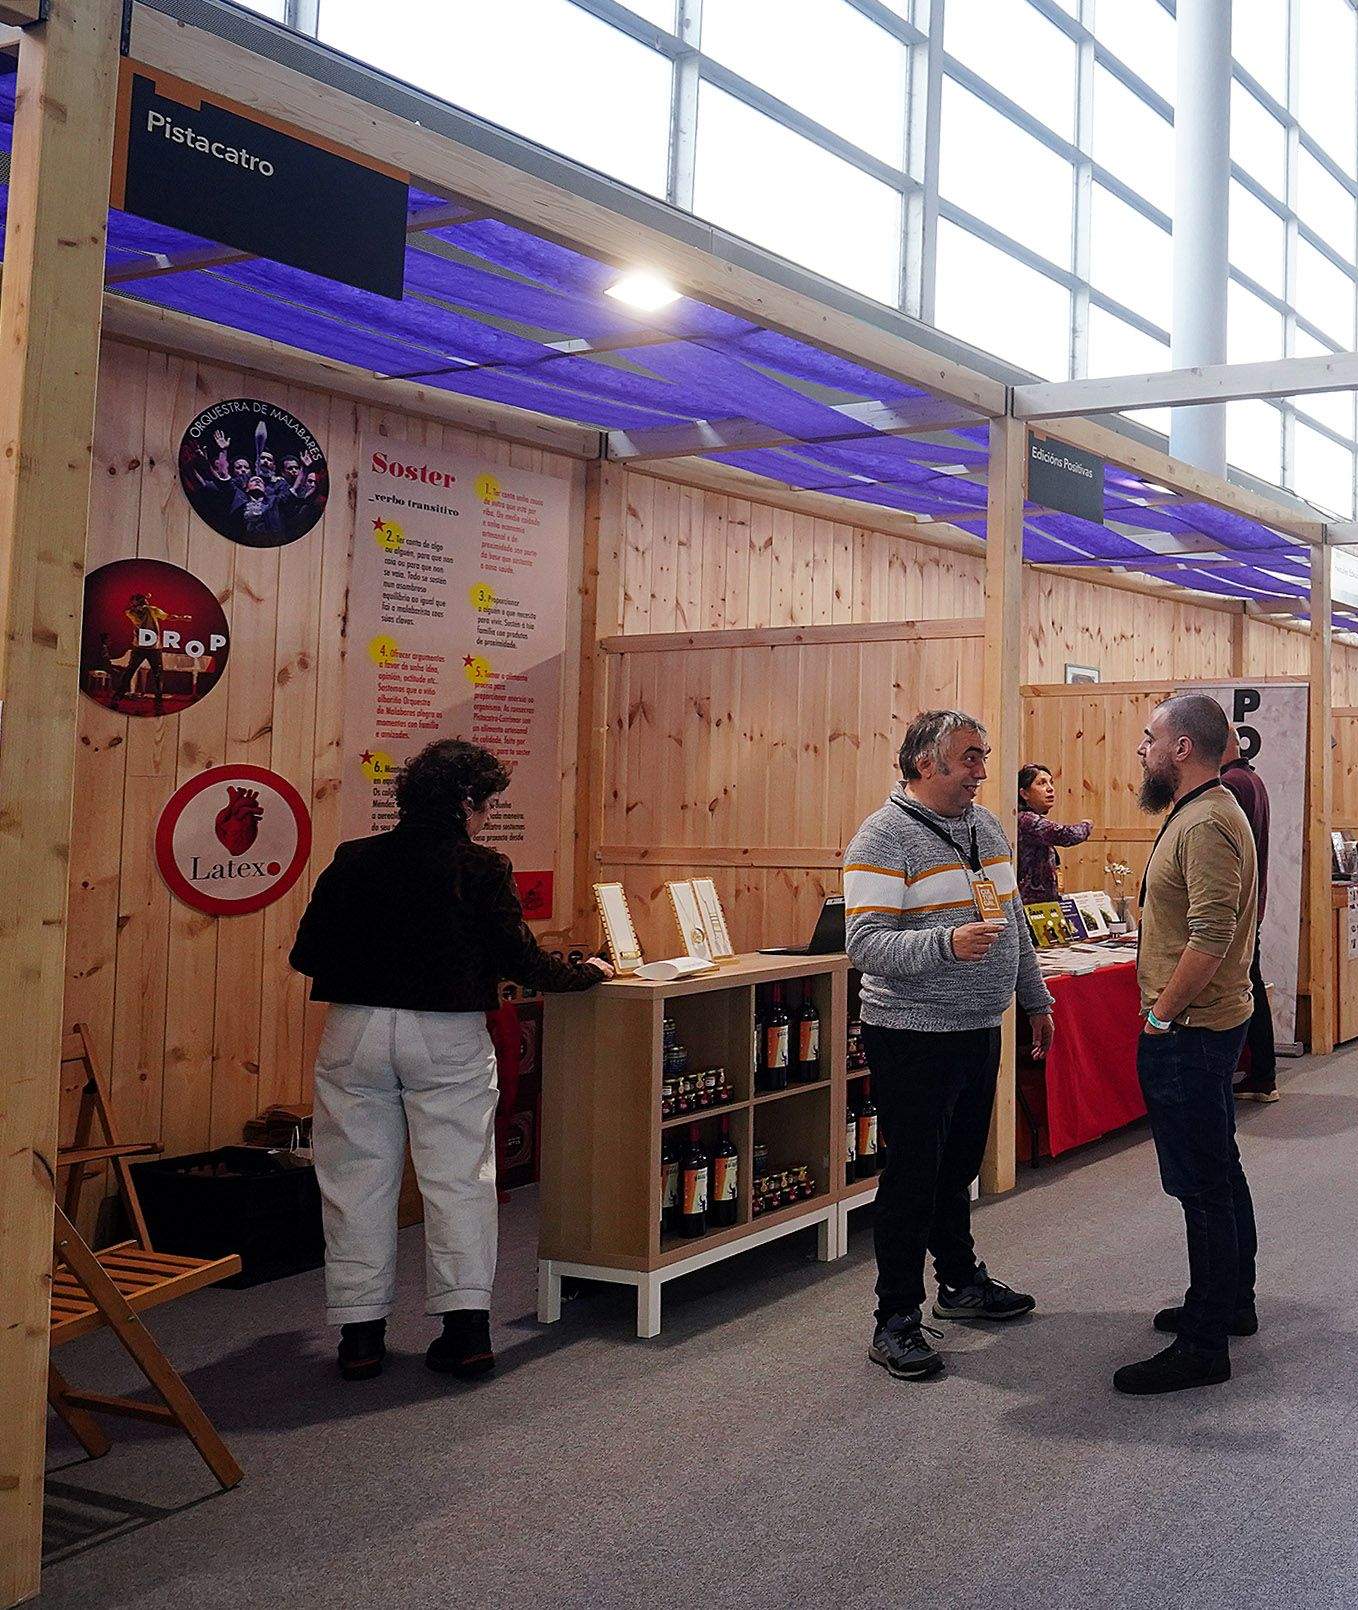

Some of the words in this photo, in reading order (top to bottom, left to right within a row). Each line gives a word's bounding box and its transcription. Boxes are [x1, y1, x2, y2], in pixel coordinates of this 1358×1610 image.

[147, 110, 274, 177] Pistacatro
[189, 401, 250, 439] ORQUESTRA
[252, 401, 269, 413] DE
[270, 408, 323, 462] MALABARES
[372, 452, 456, 489] Soster
[1031, 446, 1063, 469] Edicións
[408, 500, 459, 517] transitivo
[137, 628, 227, 659] DROP
[374, 760, 383, 773] 6.
